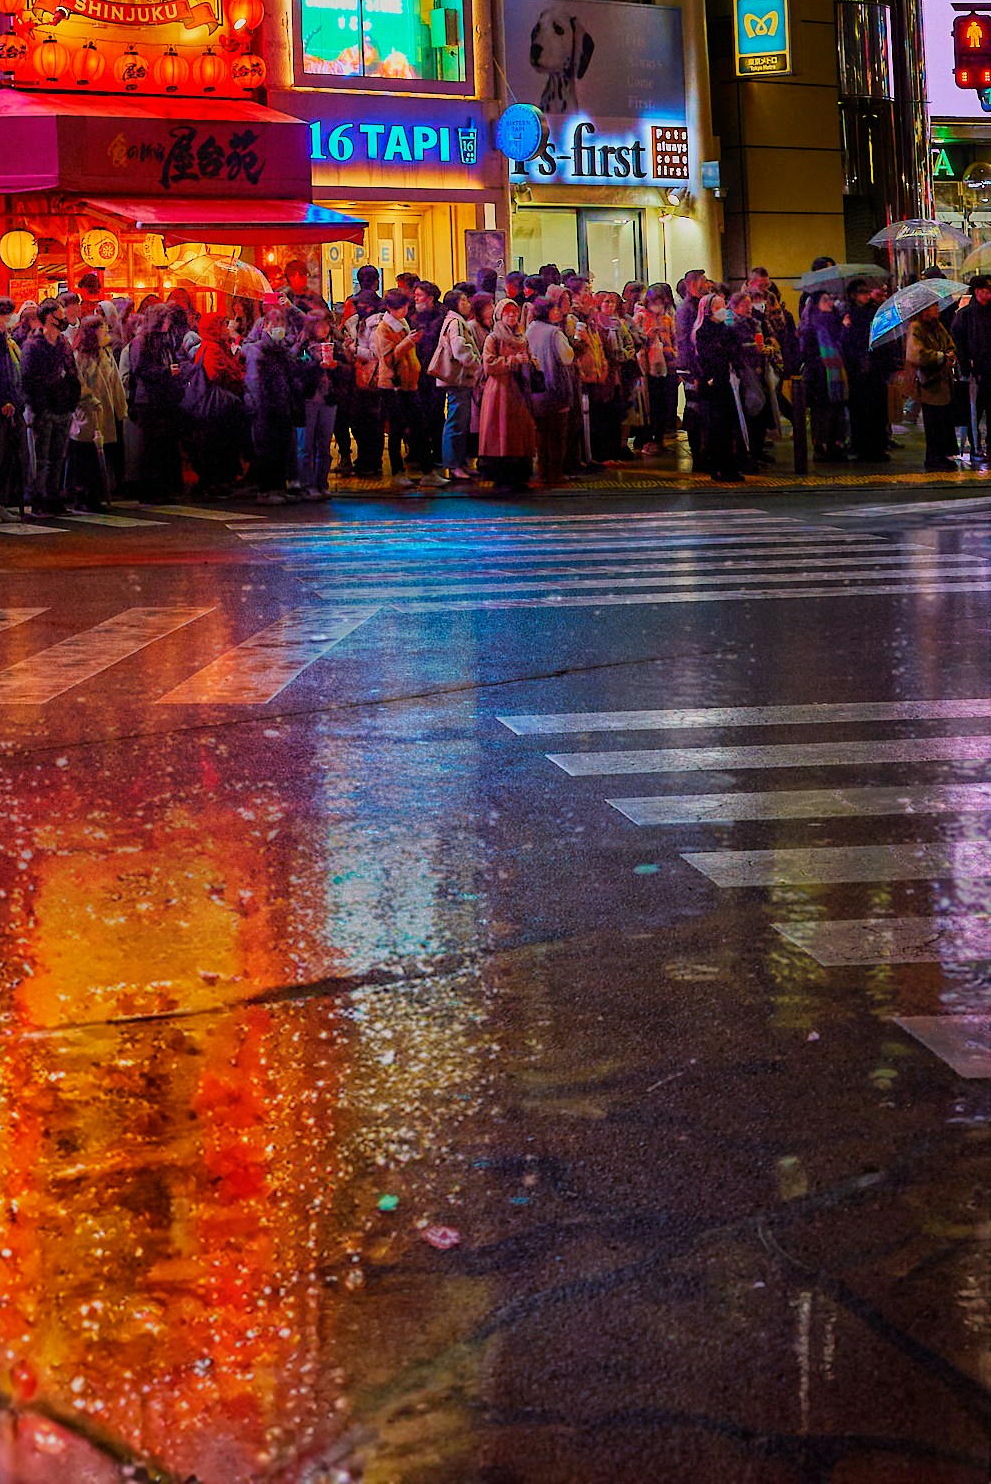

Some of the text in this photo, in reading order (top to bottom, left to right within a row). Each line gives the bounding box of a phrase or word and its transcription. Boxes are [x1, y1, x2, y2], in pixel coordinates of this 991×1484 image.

[655, 128, 687, 140] Pets
[309, 120, 474, 163] 16 TAPI 16
[656, 154, 688, 165] come
[656, 165, 688, 177] first
[328, 245, 416, 263] OPEN
